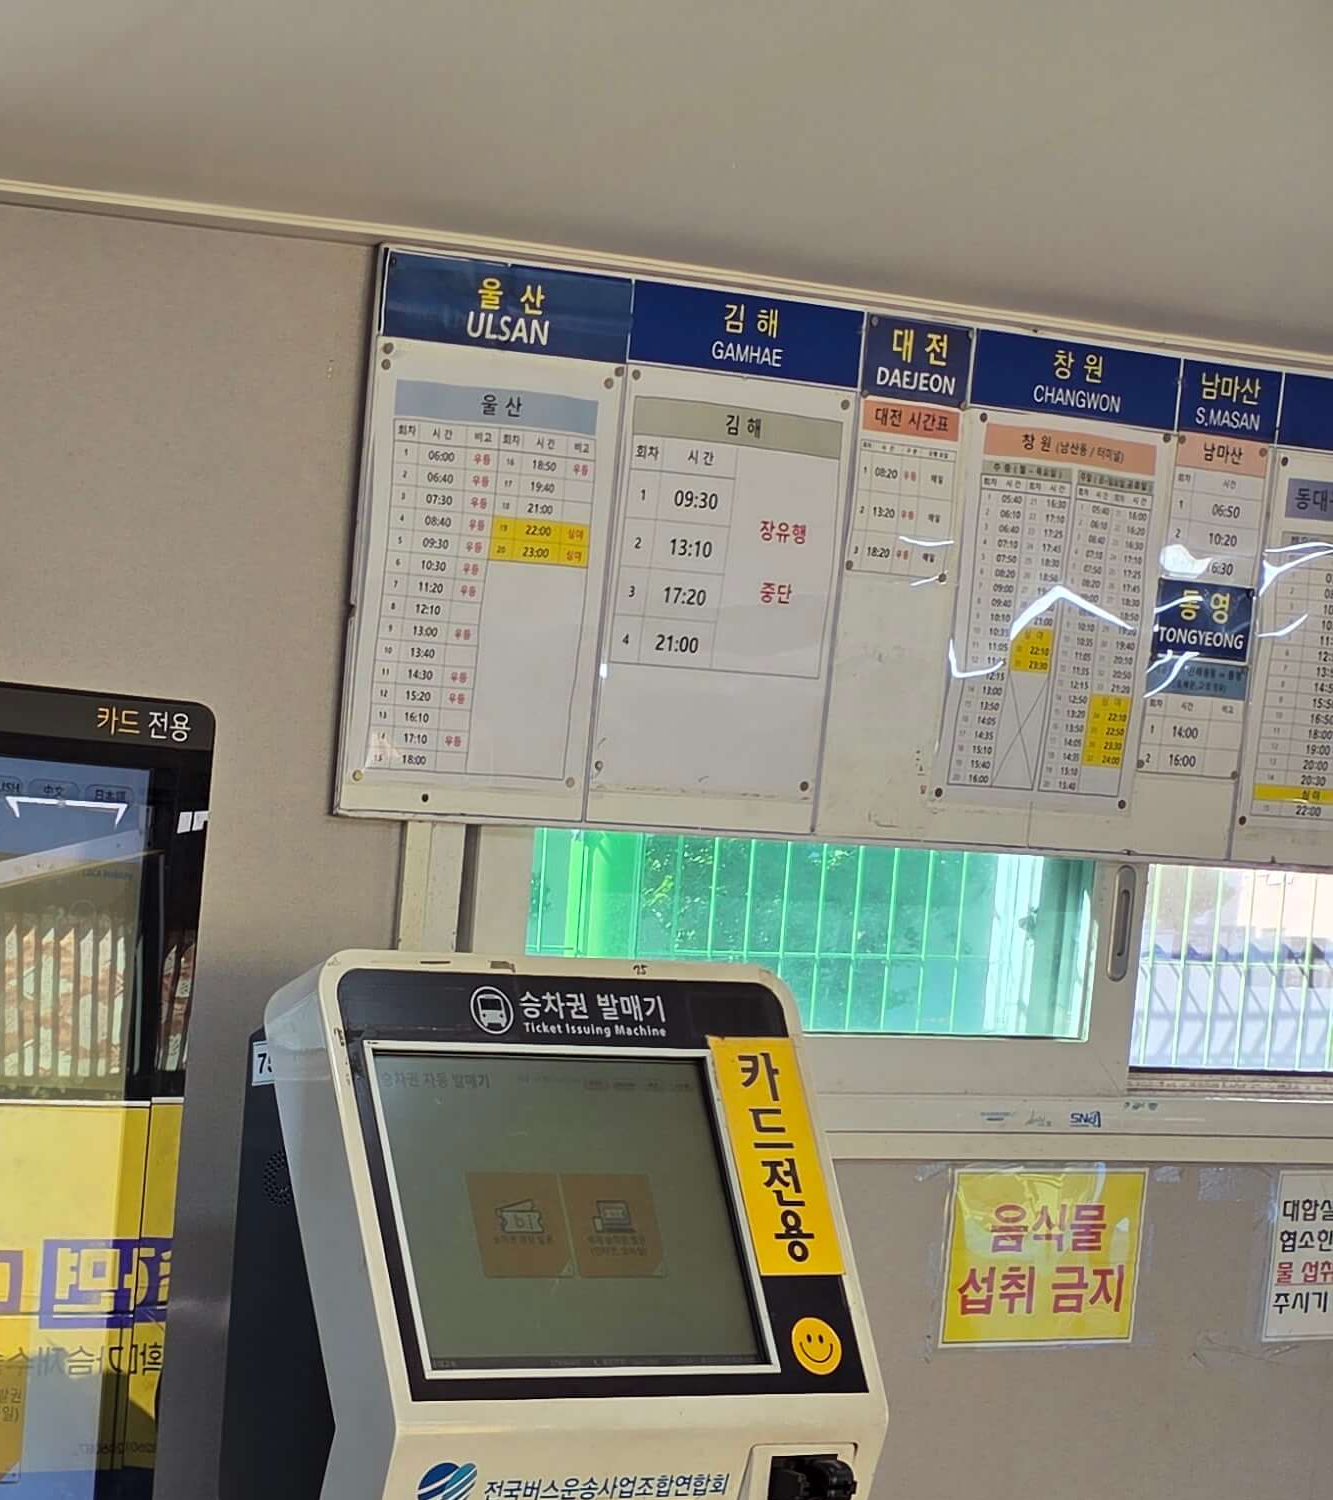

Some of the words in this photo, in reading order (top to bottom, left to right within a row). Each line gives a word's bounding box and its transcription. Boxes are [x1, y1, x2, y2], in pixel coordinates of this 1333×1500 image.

[467, 312, 549, 346] ULSAN
[712, 341, 783, 368] GAMHAE
[876, 366, 956, 395] DAEJEON
[1201, 372, 1261, 406] 남마산
[1033, 383, 1121, 414] CHANGWON
[875, 407, 902, 428] 대전
[909, 411, 949, 432] 시간표
[1195, 407, 1260, 431] S.MASAN
[428, 450, 455, 462] 06:00
[532, 459, 557, 472] 18:50
[636, 445, 660, 459] 회차
[1203, 443, 1243, 466] 남마산
[874, 466, 898, 479] 08:20
[427, 472, 454, 484] 06:40
[531, 481, 555, 494] 19:40
[426, 494, 453, 506] 07:30
[527, 503, 553, 515] 21:00
[674, 490, 718, 510] 09:30
[873, 506, 895, 519] 13:20
[1212, 504, 1240, 519] 06:50
[425, 516, 452, 528] 08:40
[526, 525, 551, 537] 22:00
[760, 521, 807, 544] 장유행
[422, 537, 449, 550] 09:30
[523, 547, 549, 558] 23:00
[670, 539, 713, 558] 13:10
[1208, 533, 1238, 548] 10:20
[866, 546, 890, 559] 18:20
[421, 560, 446, 572] 10:30
[419, 581, 444, 594] 11:20
[663, 587, 707, 606] 17:20
[760, 582, 792, 604] 중단
[415, 603, 441, 616] 12:10
[412, 625, 438, 638] 13:00
[1158, 627, 1244, 649] TONGYEONG
[410, 647, 435, 659] 13:40
[655, 634, 699, 654] 21:00
[407, 669, 433, 681] 14:30
[405, 690, 431, 702] 15:20
[96, 706, 141, 736] 카드
[148, 710, 192, 742] 전용
[404, 712, 429, 723] 16:10
[404, 733, 428, 745] 17:10
[1172, 726, 1199, 740] 14:00
[402, 754, 427, 766] 18:00
[1169, 753, 1196, 767] 16:00
[1303, 759, 1328, 772] 20:00
[1301, 774, 1326, 786] 20:30
[1295, 805, 1321, 817] 22:00
[519, 991, 589, 1020] 승차권
[597, 993, 666, 1023] 발매기
[523, 1022, 562, 1034] Ticket
[566, 1024, 611, 1038] Issuing
[615, 1026, 667, 1038] Machine
[738, 1052, 814, 1264] 카드전용
[990, 1203, 1107, 1253] 음식물
[1276, 1261, 1294, 1285] 물
[957, 1265, 1036, 1316] 섭취
[1052, 1264, 1125, 1314] 금지
[1273, 1290, 1329, 1315] 주시기
